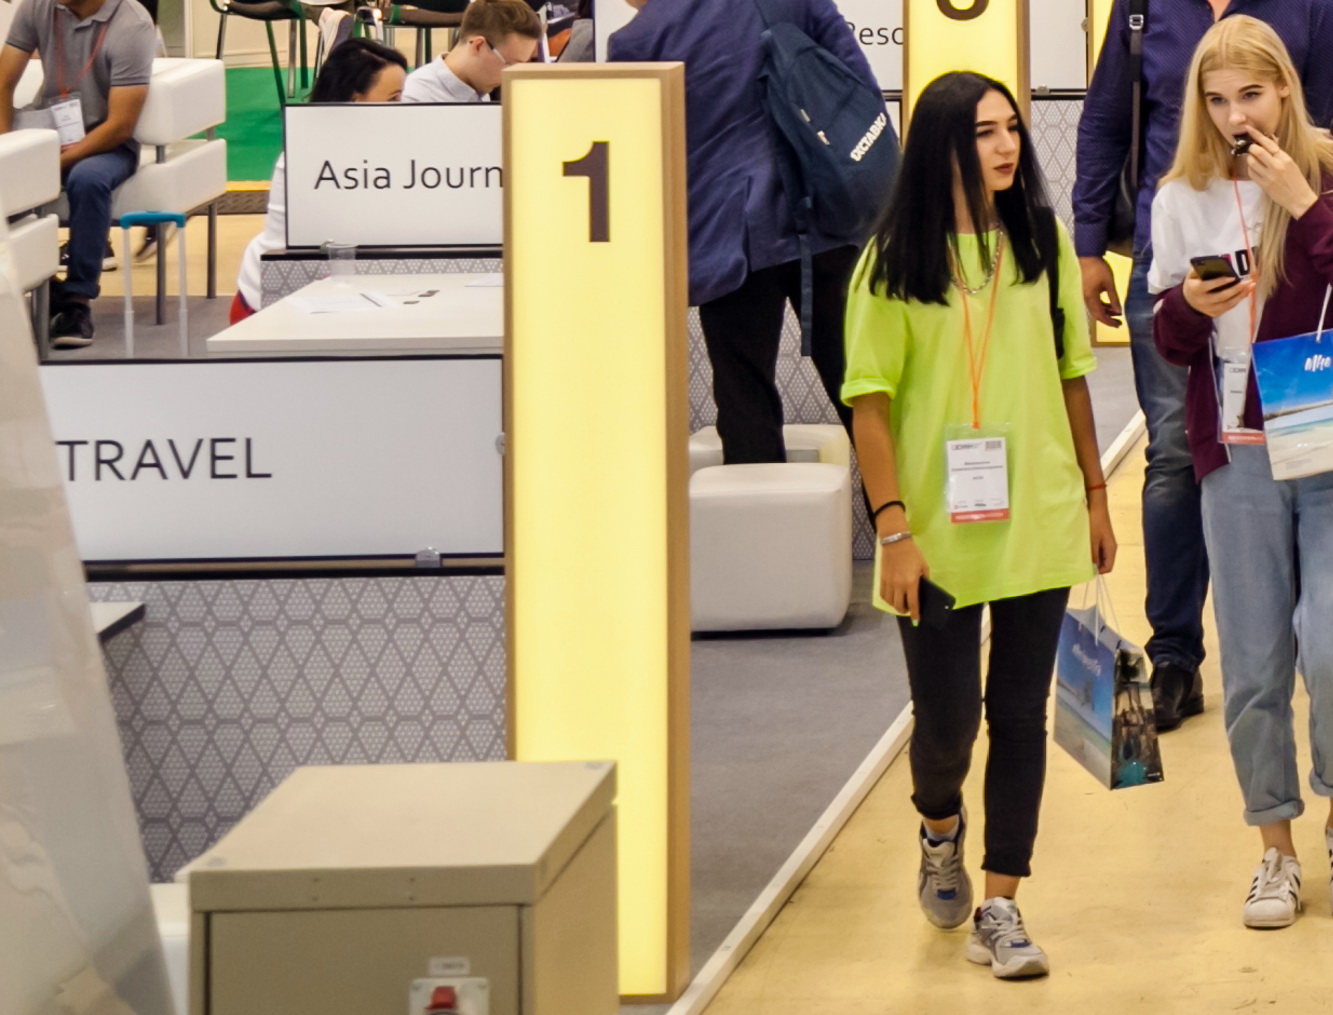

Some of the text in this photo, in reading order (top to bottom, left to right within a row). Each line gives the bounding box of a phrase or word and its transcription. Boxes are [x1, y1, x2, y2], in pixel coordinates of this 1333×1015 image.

[314, 159, 391, 190] Asia
[562, 141, 610, 244] 1
[54, 437, 273, 482] TRAVEL
